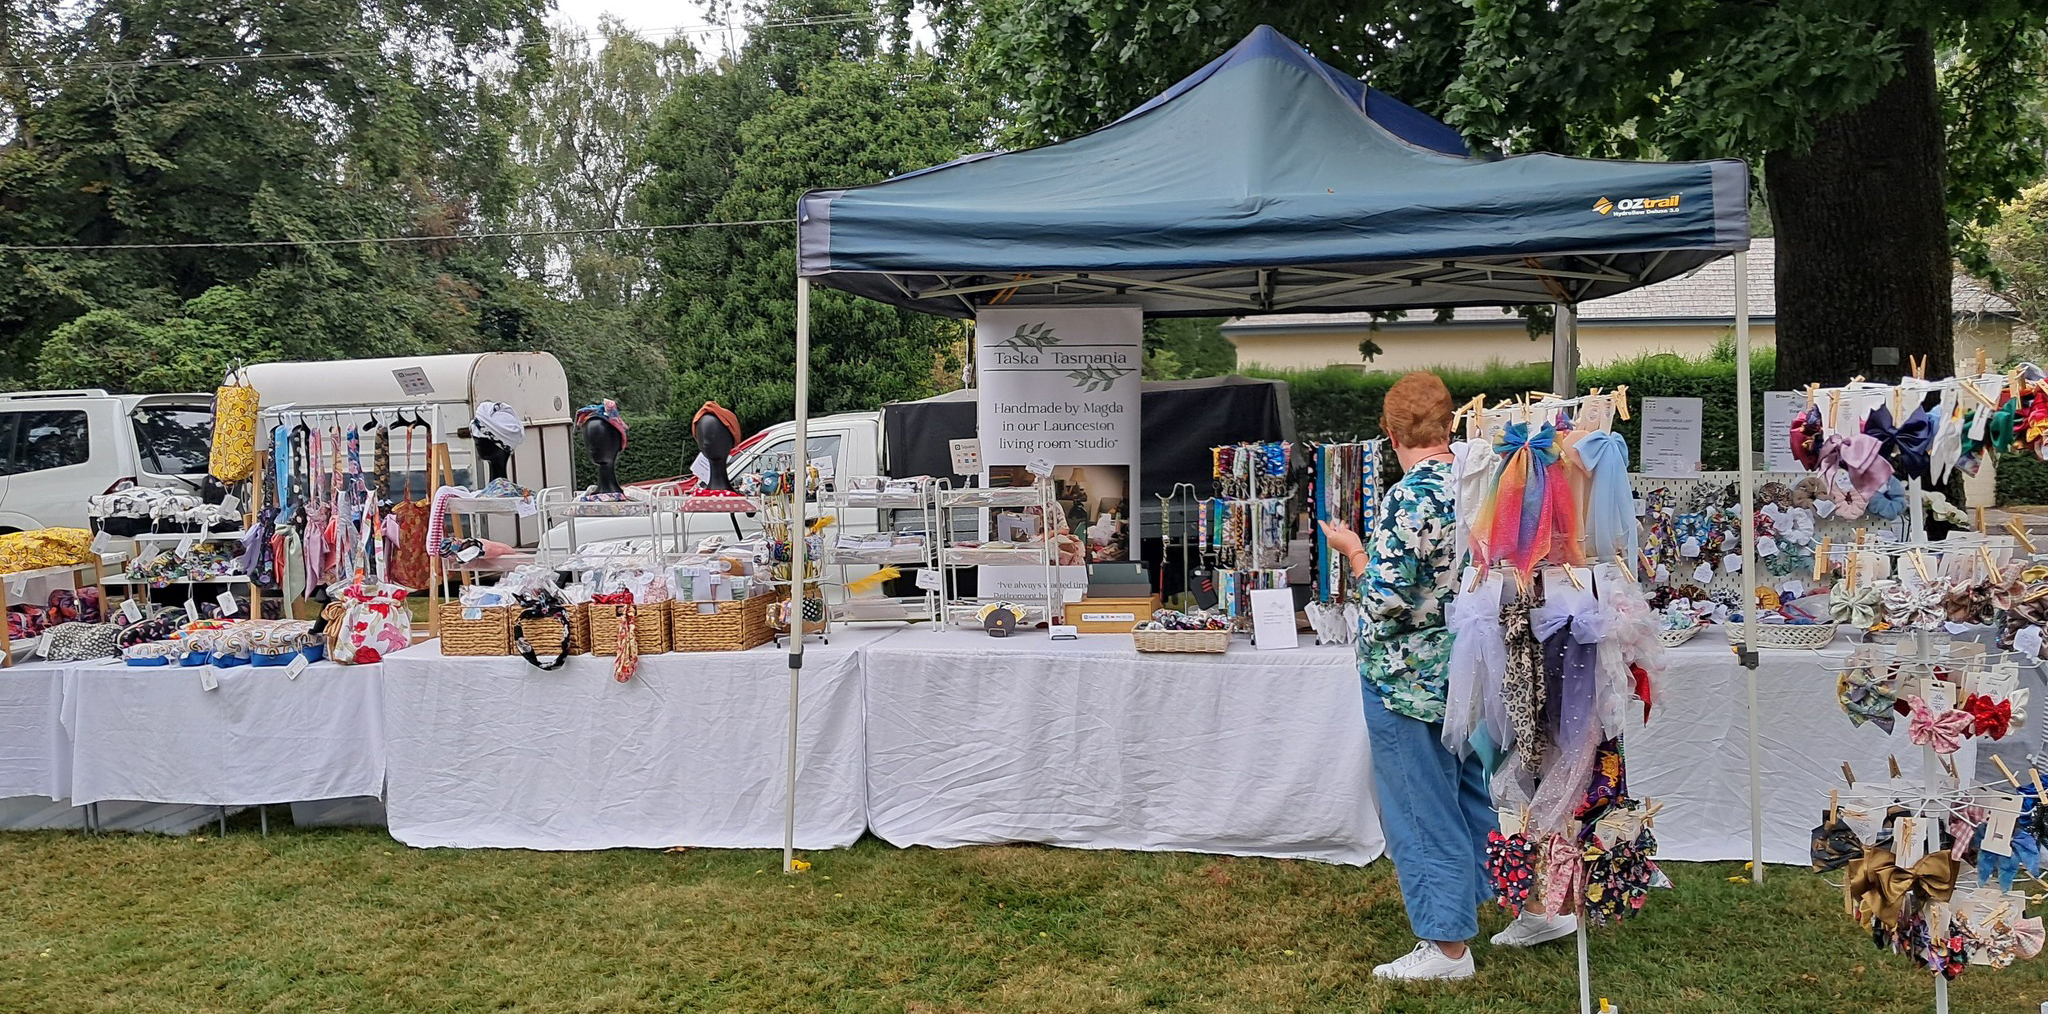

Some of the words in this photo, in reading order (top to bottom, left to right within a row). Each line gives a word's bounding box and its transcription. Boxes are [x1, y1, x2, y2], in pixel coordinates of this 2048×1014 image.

[1618, 195, 1680, 210] OZtrail
[994, 352, 1039, 365] Taska
[1051, 351, 1127, 365] Tasmania
[994, 402, 1062, 414] Handmade
[1064, 402, 1080, 415] by
[1083, 402, 1124, 418] Magda
[1002, 421, 1015, 432] in
[1017, 422, 1041, 432] our
[1043, 421, 1115, 432] Launceston
[999, 437, 1034, 454] living
[1036, 440, 1072, 449] room
[1074, 437, 1118, 449] "studio"
[1013, 581, 1042, 591] always
